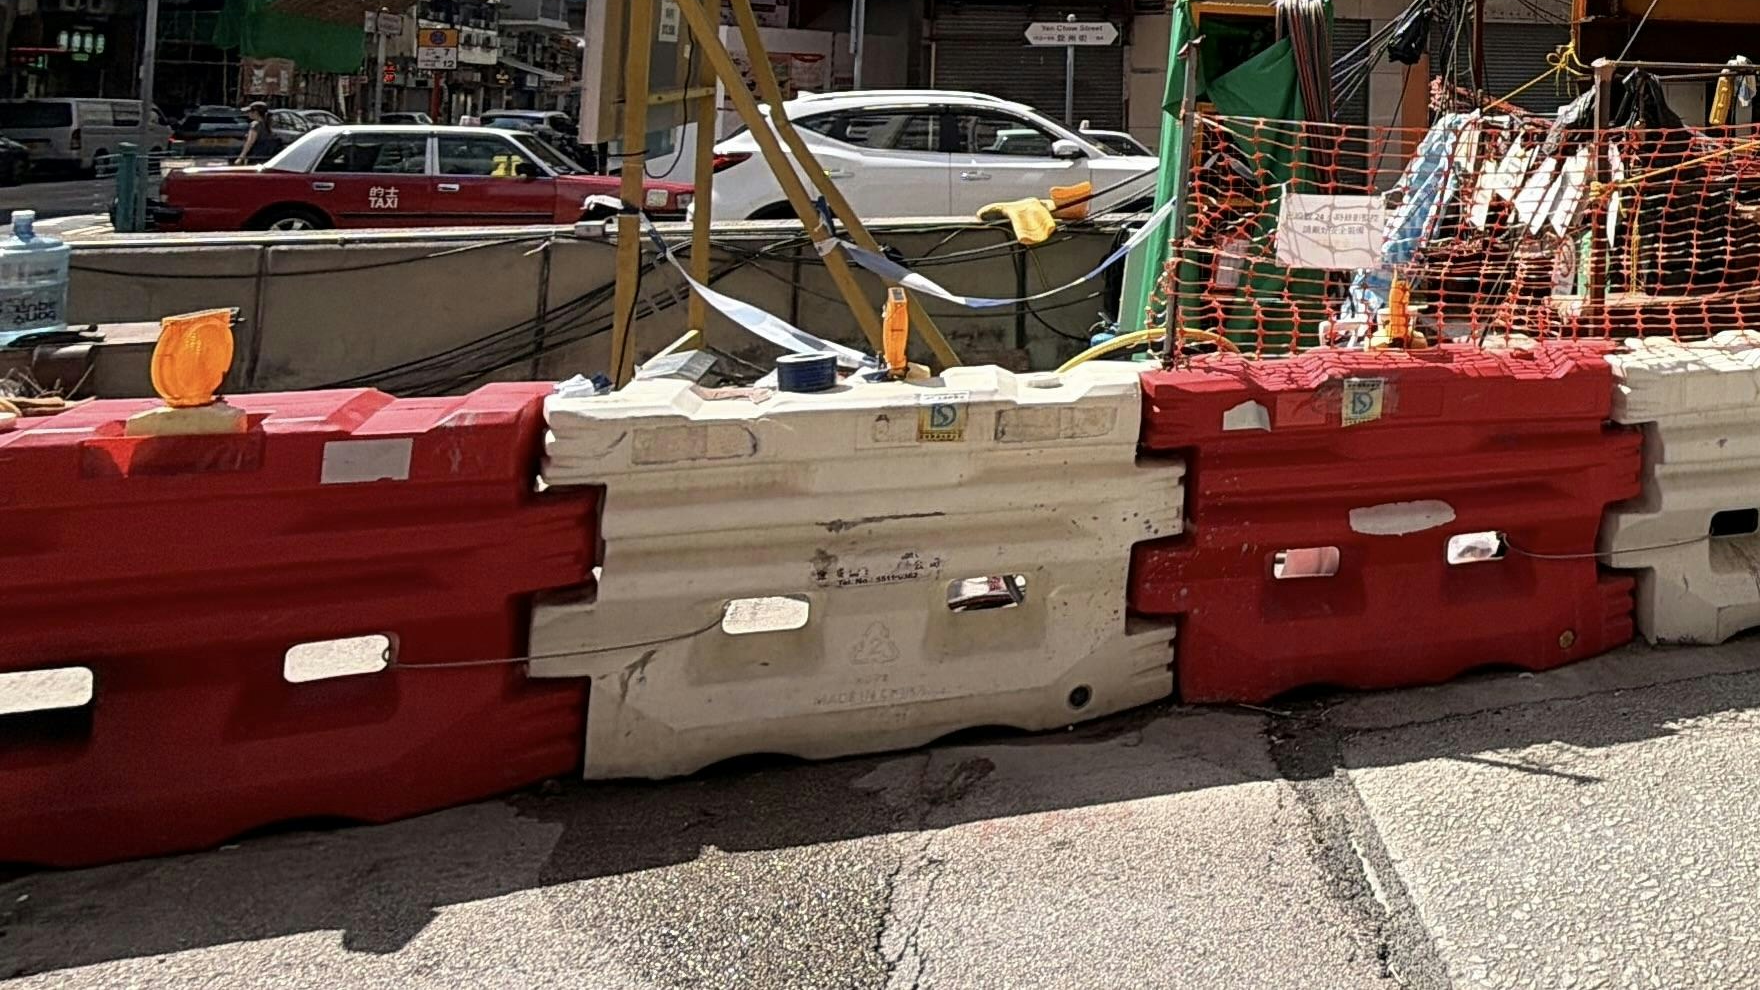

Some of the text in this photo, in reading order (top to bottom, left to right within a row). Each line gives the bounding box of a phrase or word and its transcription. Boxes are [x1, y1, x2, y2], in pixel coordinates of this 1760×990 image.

[443, 60, 454, 68] 12
[369, 186, 399, 198] 的士
[368, 197, 398, 209] TAXI
